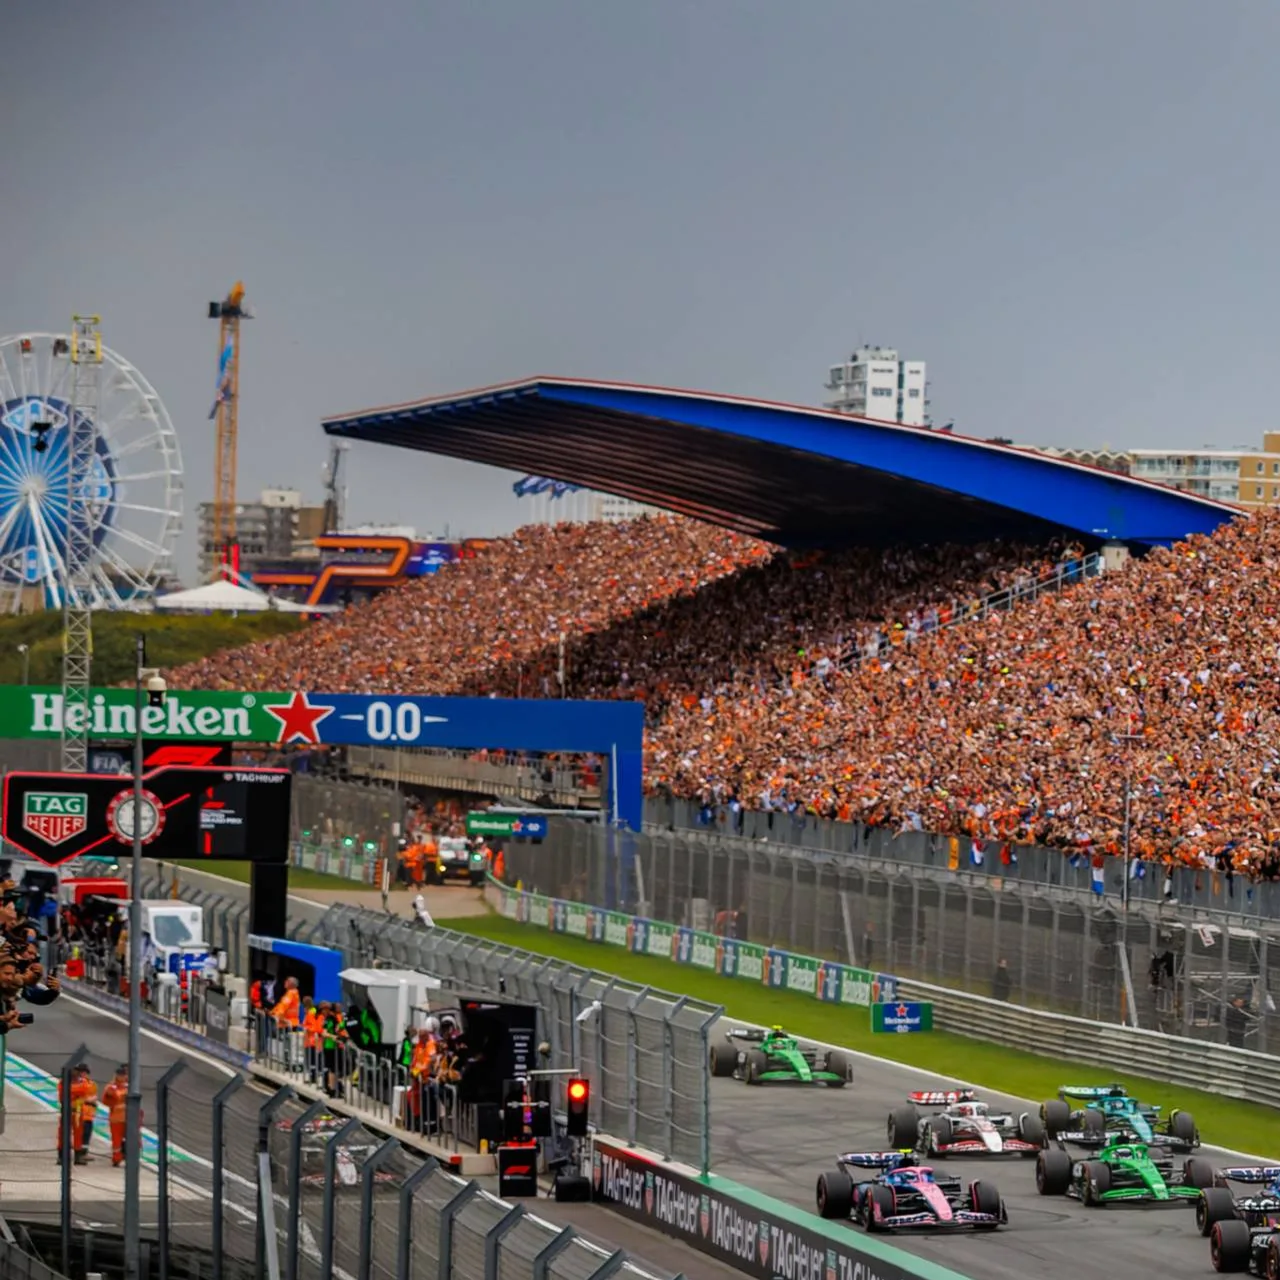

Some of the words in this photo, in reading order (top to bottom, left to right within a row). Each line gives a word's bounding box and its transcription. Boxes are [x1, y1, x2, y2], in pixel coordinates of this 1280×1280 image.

[30, 693, 252, 736] Heineken
[366, 702, 422, 743] 0.0
[31, 795, 82, 812] TAG
[27, 815, 83, 842] HEUER
